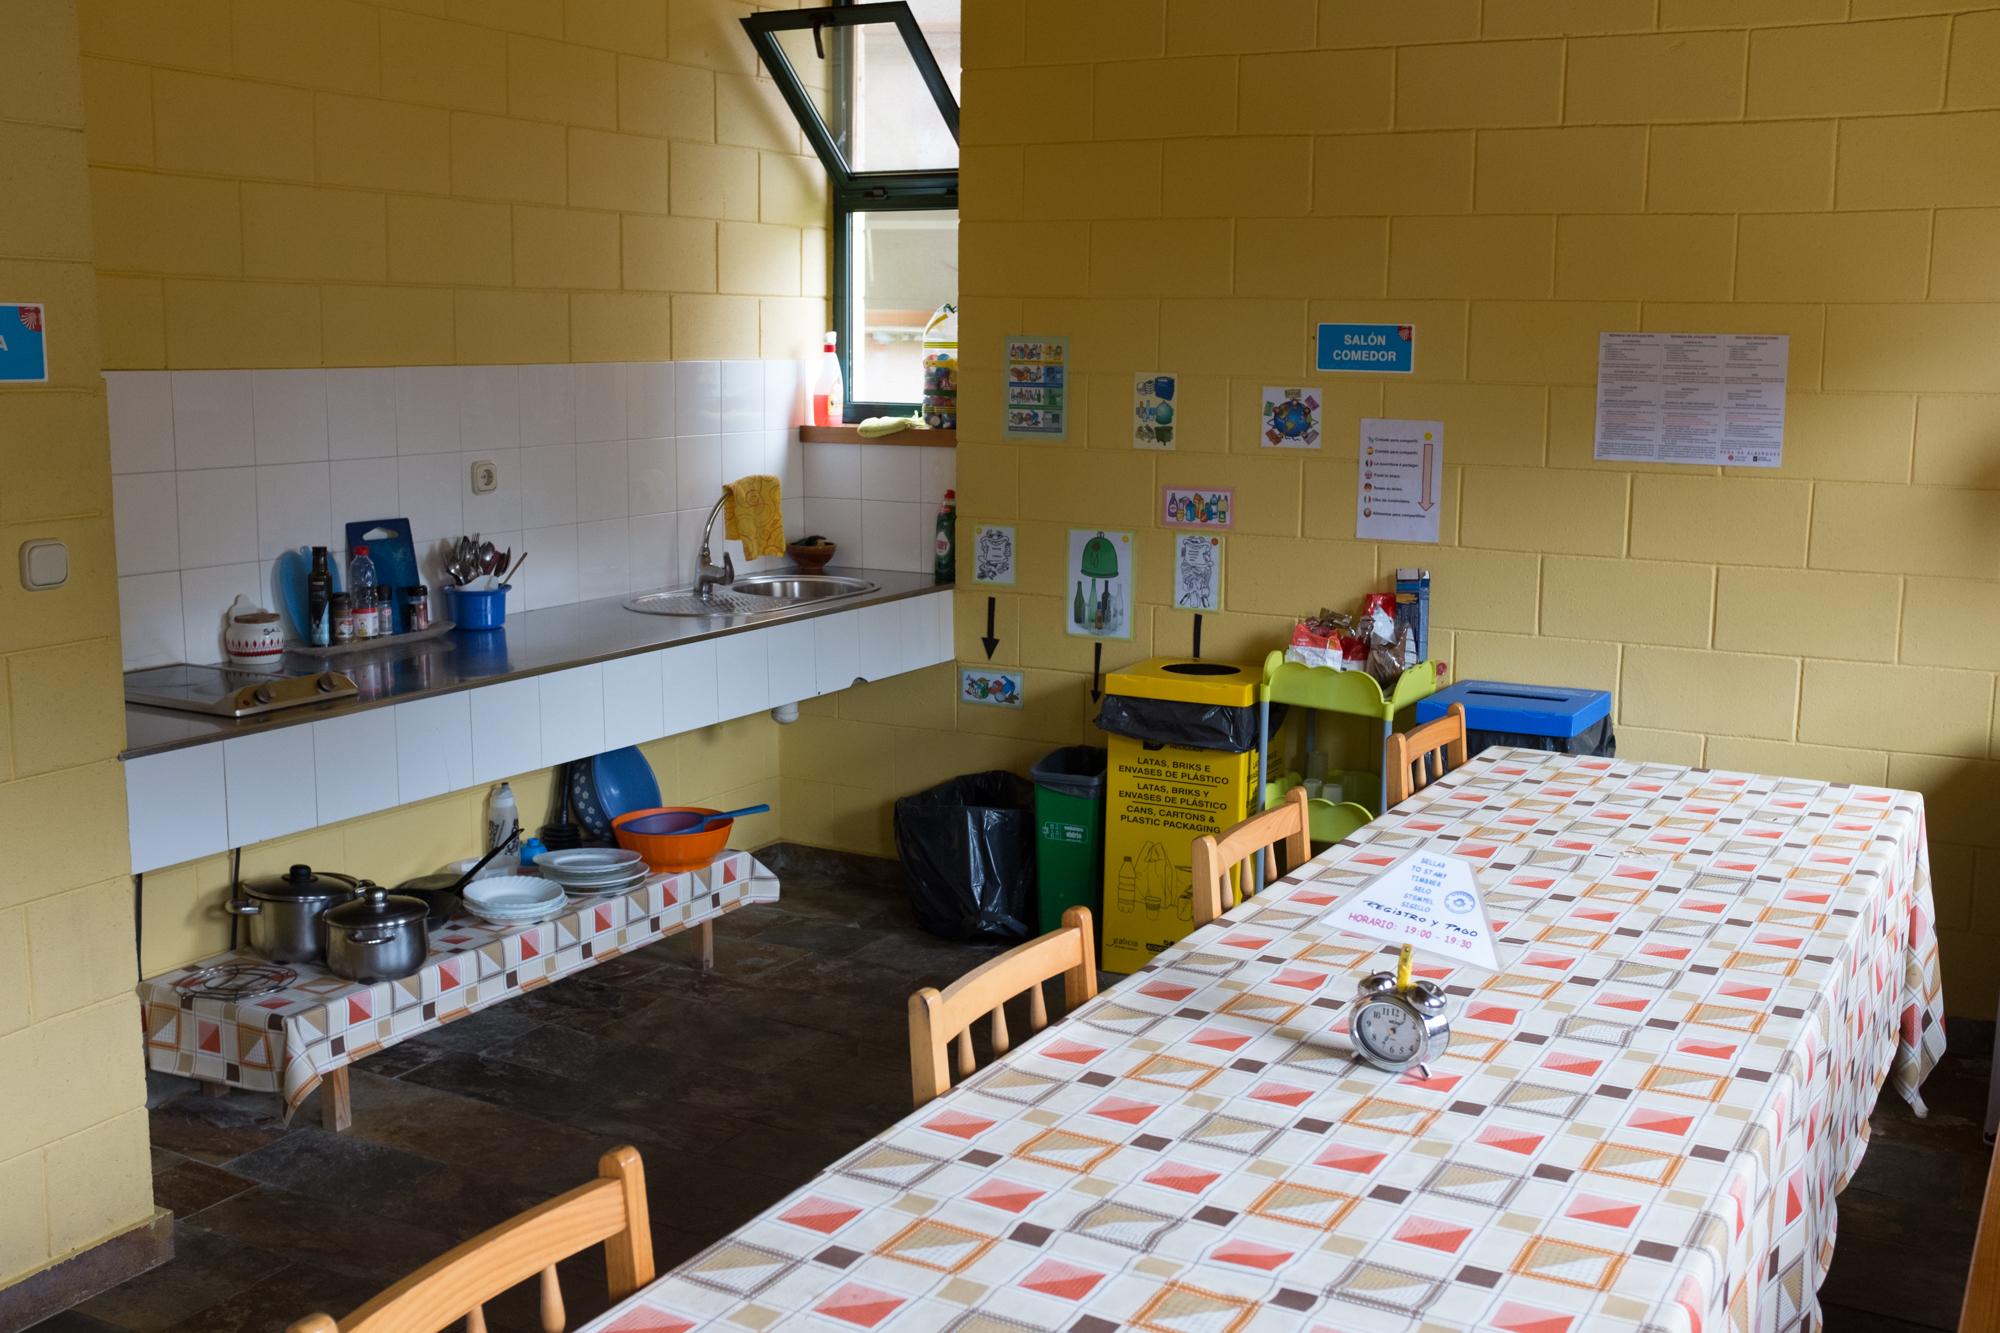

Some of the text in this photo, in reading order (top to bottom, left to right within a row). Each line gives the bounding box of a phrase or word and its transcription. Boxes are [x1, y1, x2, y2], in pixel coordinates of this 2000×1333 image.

[1344, 332, 1386, 346] SALÓN
[1333, 350, 1397, 362] COMEDOR
[1137, 756, 1211, 772] LATAS, BRIKS E
[1118, 765, 1229, 785] ENVASES DE PLÁSTICO
[1137, 783, 1169, 794] LATAS,
[1171, 787, 1201, 797] BRIKS
[1118, 790, 1228, 810] ENVASES DE PLÁSTICO
[1126, 805, 1156, 816] CANS,
[1158, 809, 1206, 823] CARTONS
[1120, 814, 1221, 834] PLASTIC PACKAGING
[1420, 857, 1446, 869] SELLAR
[1414, 886, 1432, 895] SELO
[1401, 901, 1431, 913] SIGILLO
[1348, 912, 1396, 930] HORARIO:
[1404, 926, 1432, 939] 19:00
[1444, 935, 1473, 949] 19:30
